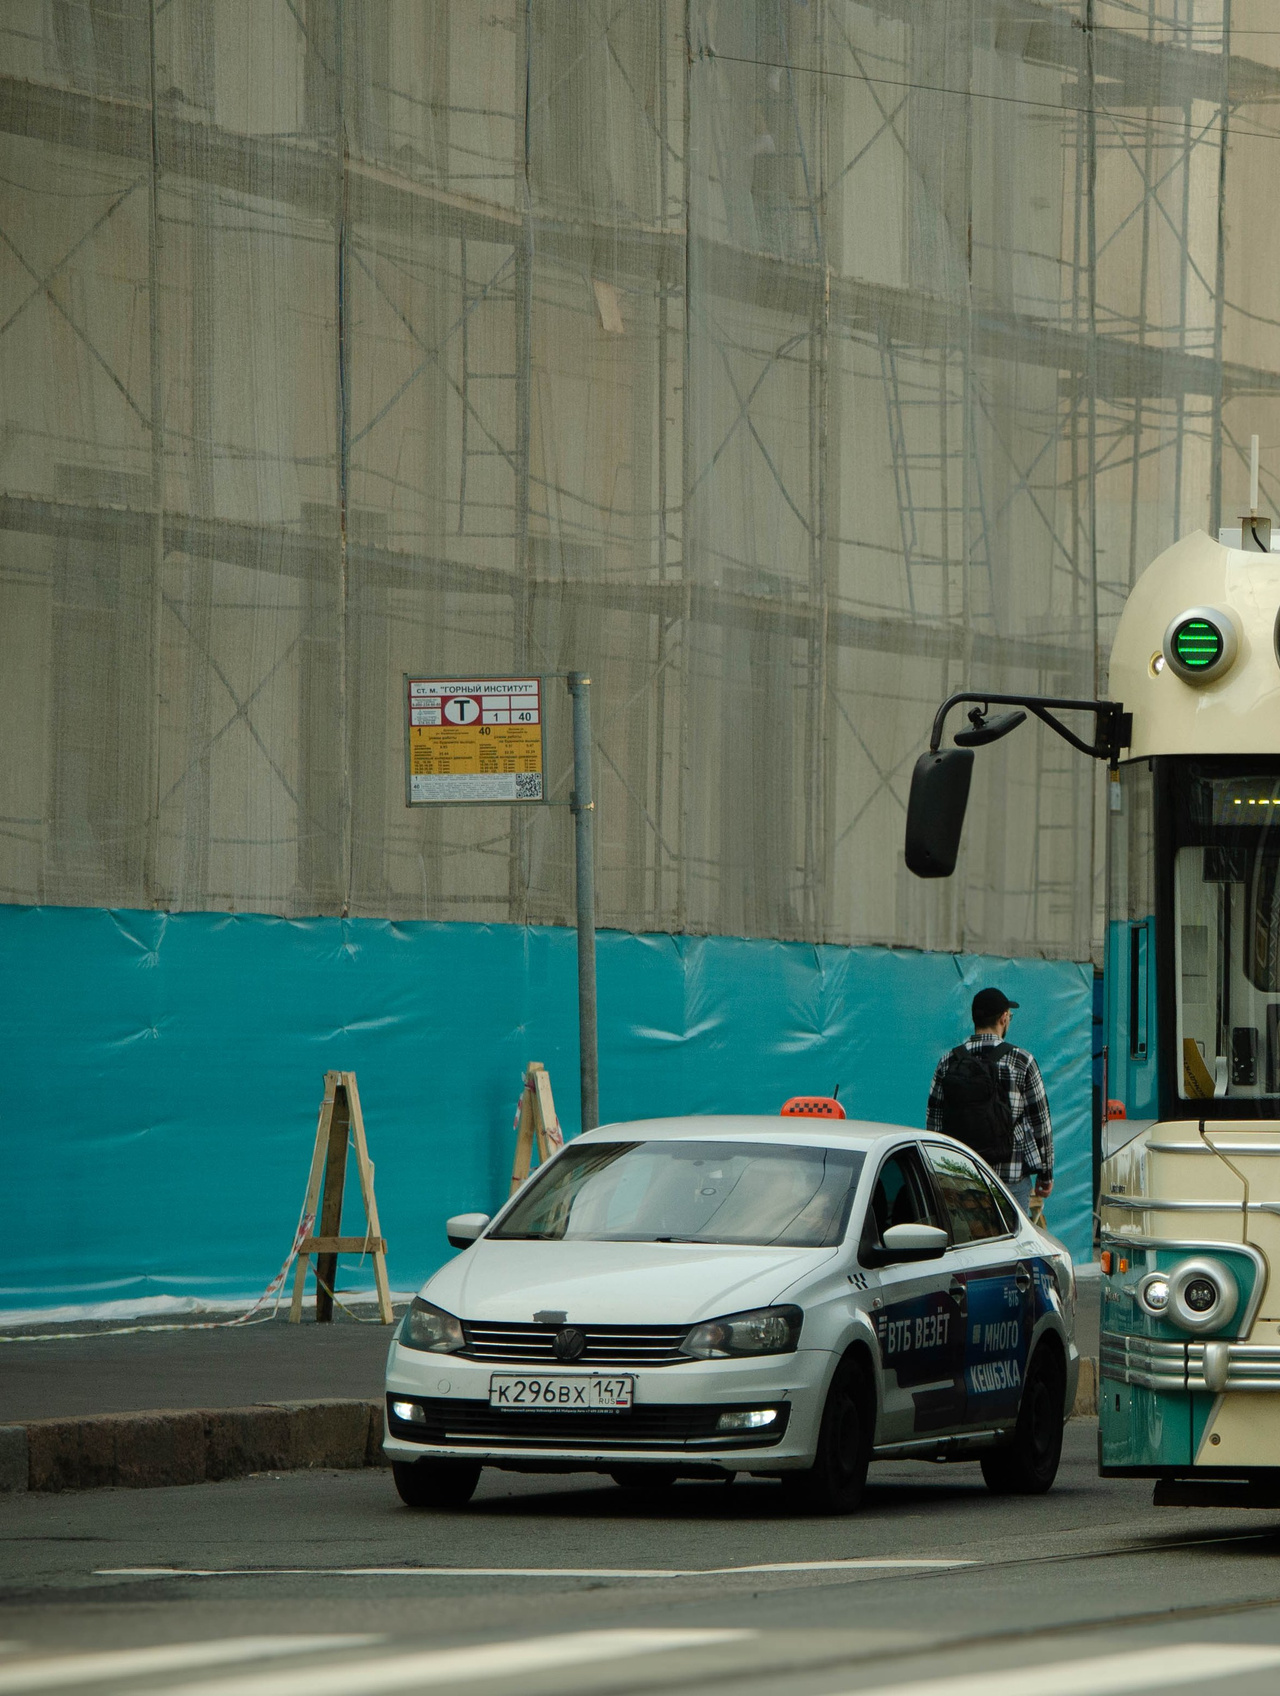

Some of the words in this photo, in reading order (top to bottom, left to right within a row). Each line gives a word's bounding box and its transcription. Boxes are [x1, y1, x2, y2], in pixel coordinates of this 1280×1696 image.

[440, 684, 482, 693] "ГОРНЫЙ
[483, 684, 533, 693] ИНСТИТУТ"
[493, 712, 499, 722] 1
[518, 712, 532, 722] 40
[416, 727, 422, 737] 1
[478, 726, 491, 736] 40
[887, 1319, 912, 1354] ВТБ
[915, 1306, 950, 1350] ВЕЗЁТ
[983, 1319, 1019, 1352] МНОГО
[970, 1359, 1021, 1393] КЕШБЭКА
[593, 1380, 625, 1398] 147
[598, 1397, 616, 1405] RUS
